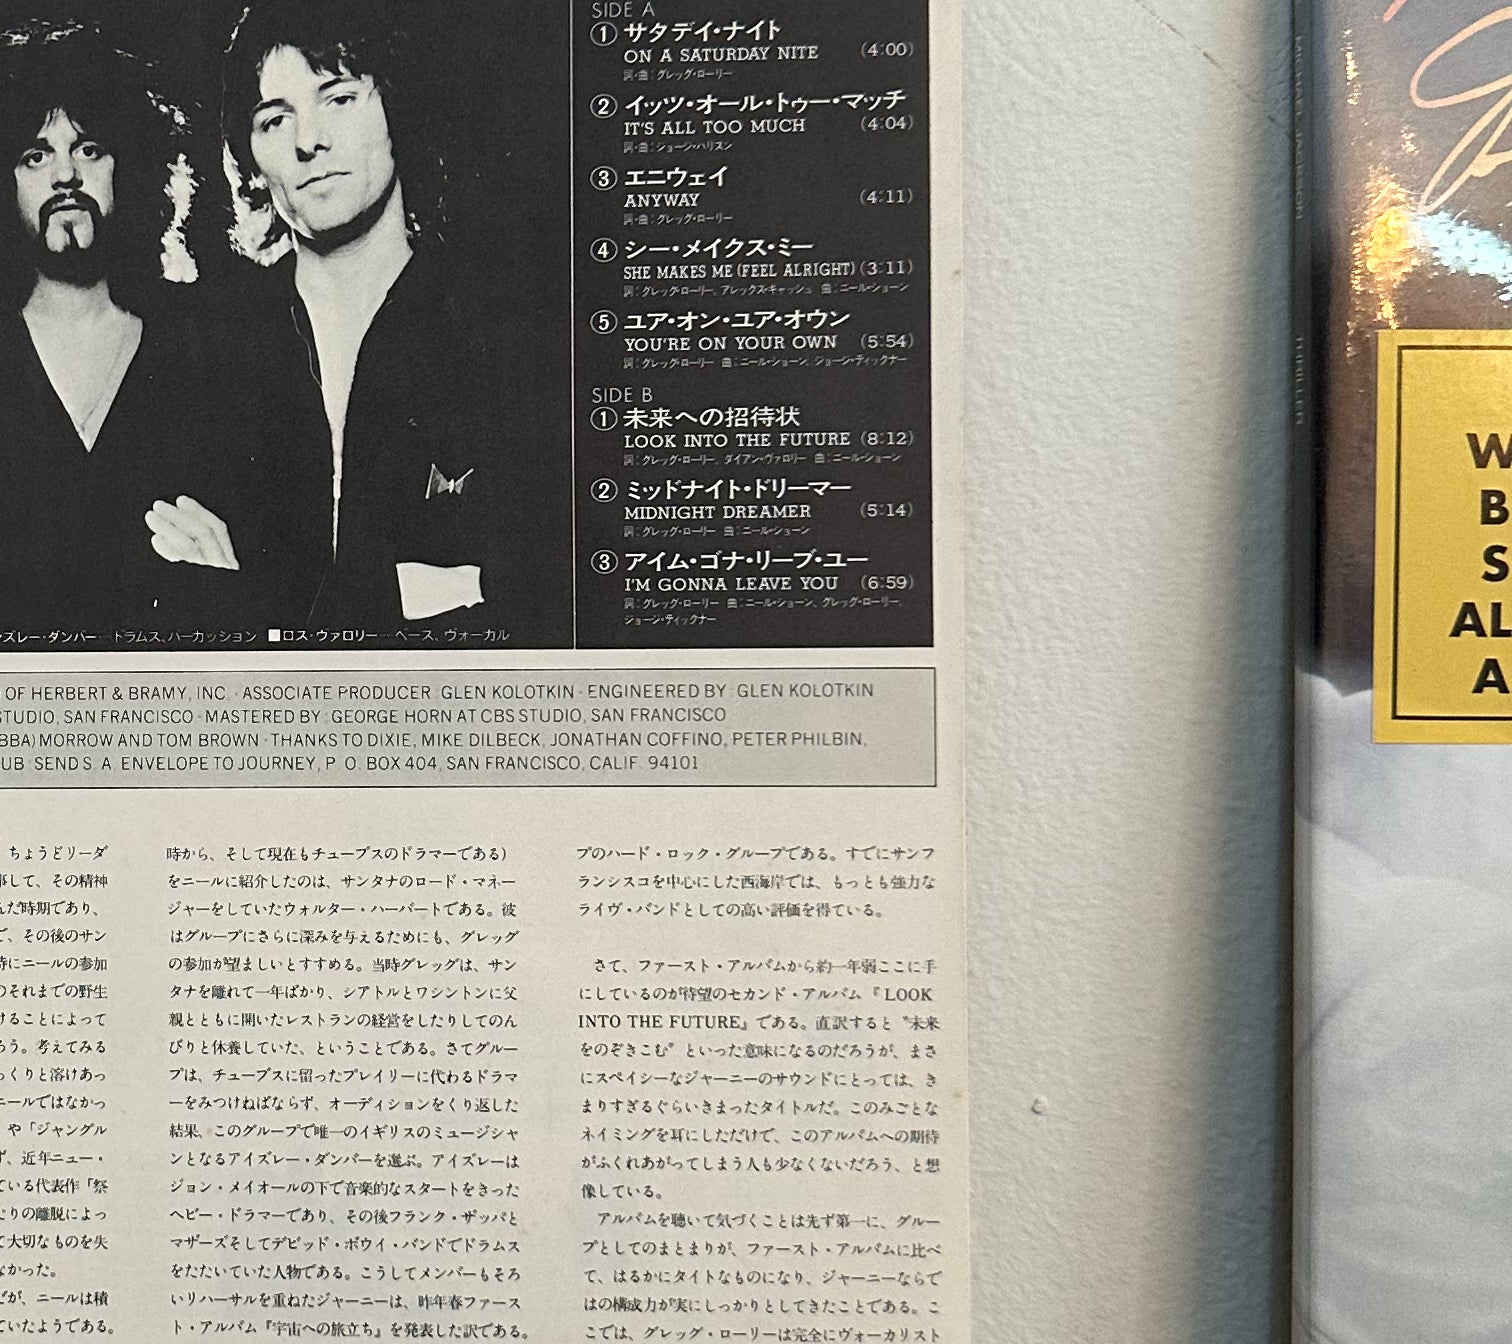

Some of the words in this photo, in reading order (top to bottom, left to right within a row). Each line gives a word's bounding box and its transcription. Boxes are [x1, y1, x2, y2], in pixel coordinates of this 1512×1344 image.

[592, 1, 632, 18] SIDE
[642, 2, 655, 17] A
[624, 49, 652, 63] ON
[660, 49, 672, 62] A
[680, 46, 770, 61] SATURDAY
[777, 46, 818, 59] NITE
[862, 42, 913, 57] (4:00)
[624, 122, 654, 135] IT'S
[661, 121, 695, 134] ALL
[703, 120, 742, 133] TOO
[751, 119, 805, 132] MUCH
[861, 115, 913, 131] (4:04)
[624, 193, 700, 207] ANYWAY
[860, 189, 912, 204] (4:11)
[624, 266, 651, 279] SHE
[657, 265, 706, 279] MAKES
[712, 265, 733, 278] ME
[737, 263, 777, 277] (FEEL
[783, 262, 855, 276] ALRIGHT)
[860, 260, 912, 275] (3:11)
[624, 338, 690, 351] YOU'RE
[699, 337, 727, 350] ON
[735, 336, 785, 349] YOUR
[792, 335, 837, 349] OWN
[861, 334, 913, 349] (5:54)
[592, 387, 632, 403] SIDE
[642, 387, 652, 402] B
[625, 435, 676, 448] LOOK
[684, 434, 728, 447] INTO
[736, 434, 771, 446] THE
[780, 432, 850, 446] FUTURE
[861, 431, 913, 446] (8:12)
[625, 506, 715, 519] MIDNIGHT
[723, 505, 811, 518] DREAMER
[861, 503, 912, 517] (5:14)
[625, 578, 650, 591] I'M
[658, 578, 727, 591] GONNA
[736, 577, 791, 590] LEAVE
[800, 577, 838, 590] YOU
[861, 575, 913, 589] (6:59)
[6, 687, 26, 700] OF
[32, 687, 107, 700] HERBERT
[243, 686, 332, 700] ASSOCIATE
[339, 686, 430, 700] PRODUCER
[442, 685, 485, 699] GLEN
[493, 685, 574, 699] KOLOTKIN
[588, 684, 699, 698] ENGINEERED
[705, 684, 726, 698] BY
[737, 684, 783, 697] GLEN
[790, 683, 873, 697] KOLOTKIN
[64, 710, 95, 724] SAN
[101, 710, 193, 723] FRANCISCO
[206, 710, 294, 723] MASTERED
[300, 710, 320, 723] BY
[332, 710, 398, 723] GEORGE
[405, 709, 452, 723] HORN
[457, 709, 476, 723] AT
[481, 709, 514, 723] CBS
[591, 708, 623, 722] SAN
[631, 707, 726, 722] FRANCISCO
[40, 733, 113, 747] MORROW
[118, 734, 152, 747] AND
[157, 733, 191, 747] TOM
[199, 733, 258, 747] BROWN
[271, 733, 337, 747] THANKS
[342, 733, 362, 747] TO
[422, 733, 463, 747] MIKE
[550, 733, 641, 746] JONATHAN
[733, 732, 787, 746] PETER
[122, 757, 208, 770] ENVELOPE
[213, 756, 233, 770] TO
[367, 756, 400, 770] BOX
[447, 756, 479, 770] SAN
[648, 756, 698, 770] 94101
